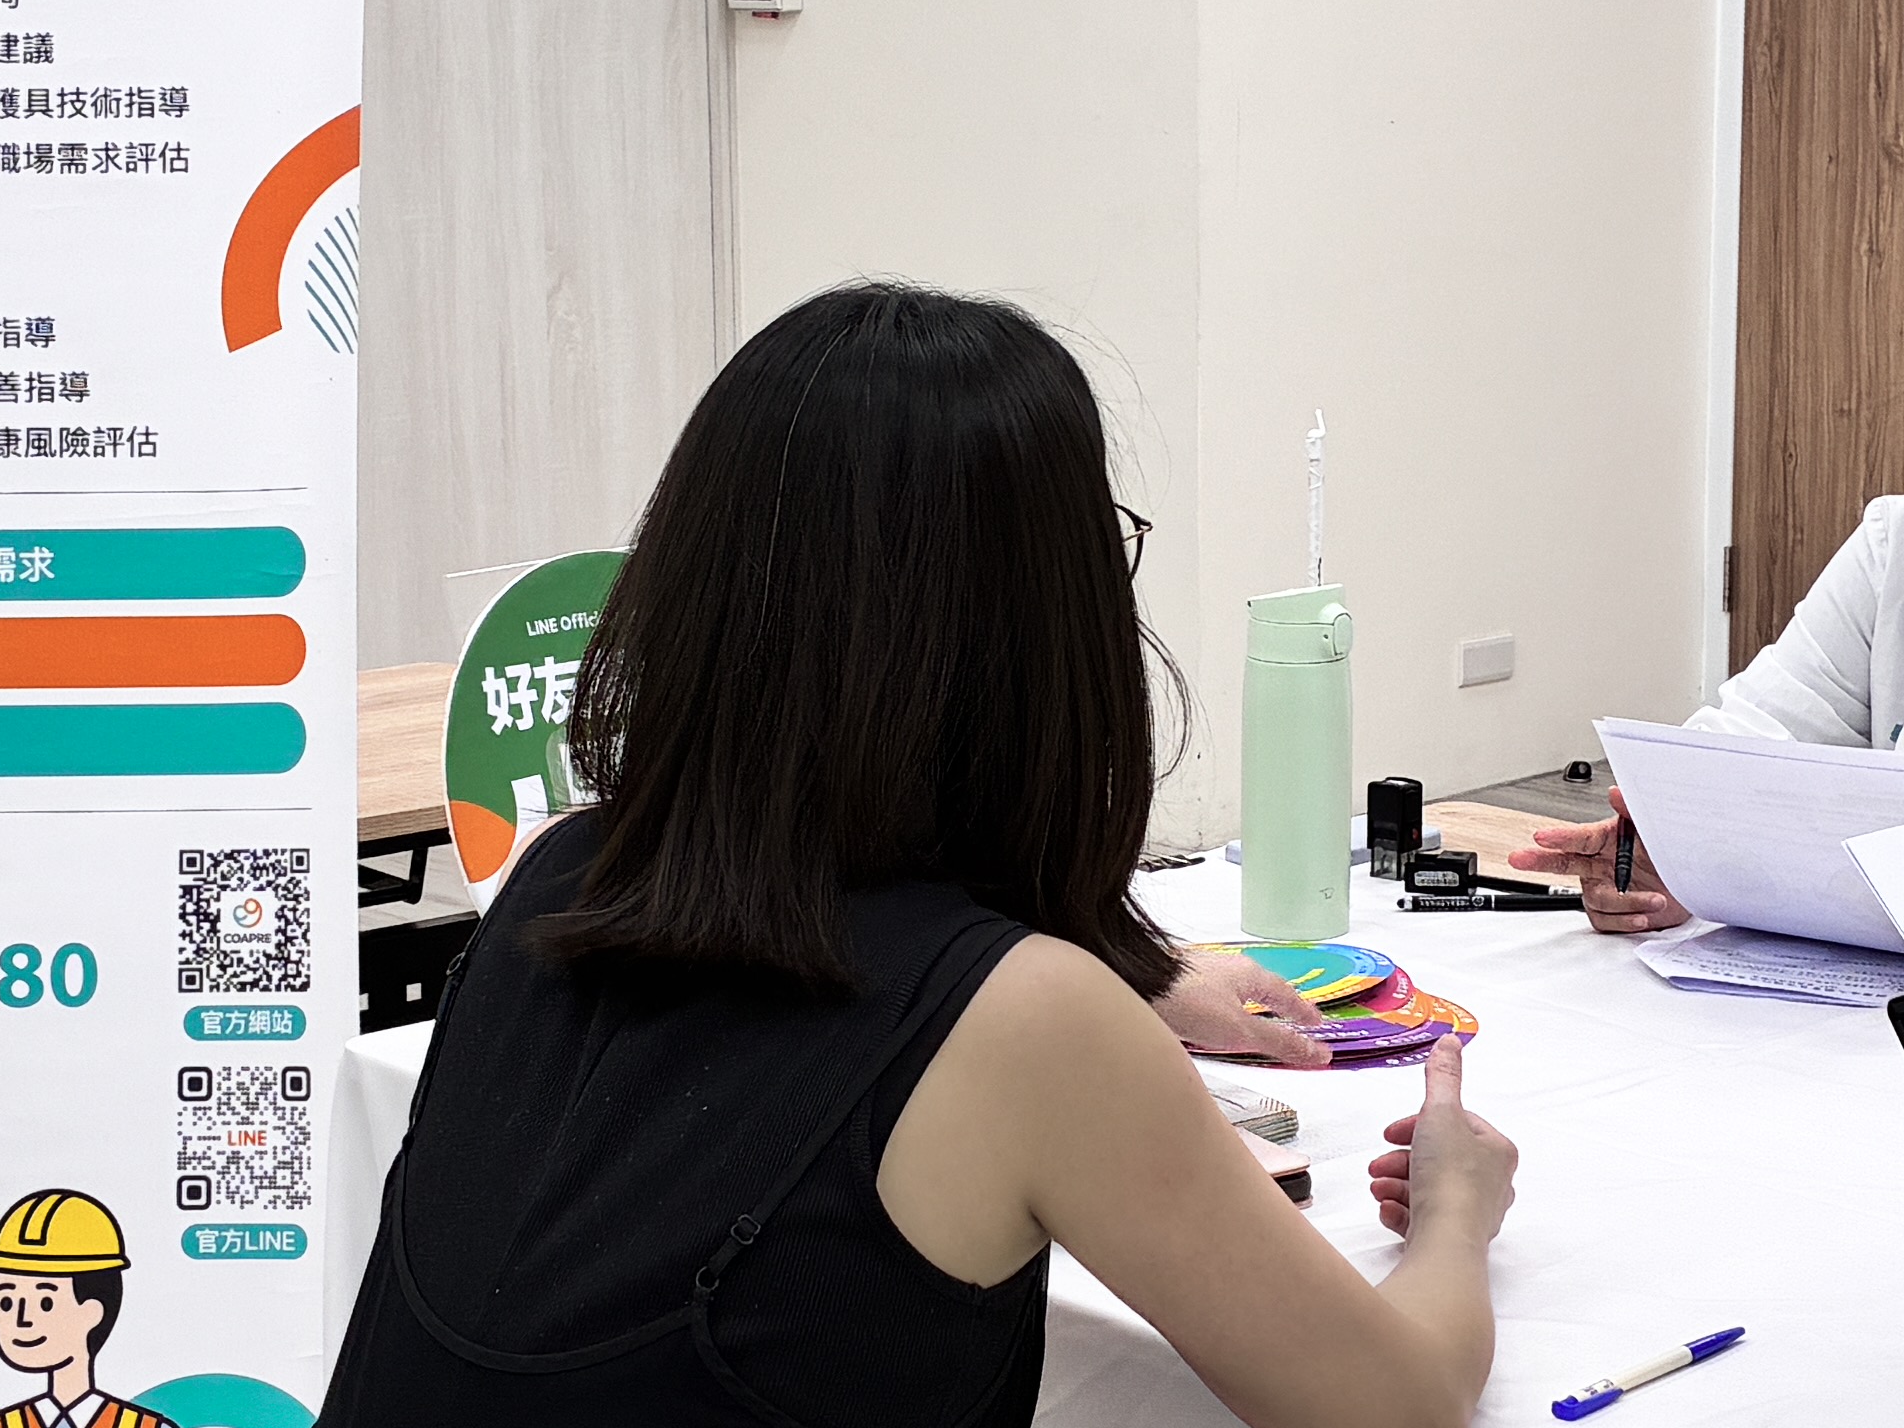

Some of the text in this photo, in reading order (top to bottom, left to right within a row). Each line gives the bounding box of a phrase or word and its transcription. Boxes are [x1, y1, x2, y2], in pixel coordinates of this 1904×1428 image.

[525, 610, 599, 637] LINE Offic
[223, 931, 273, 946] COAPRE
[199, 1009, 295, 1038] 官方網站
[227, 1128, 270, 1149] LINE
[194, 1229, 298, 1256] 官方LINE
